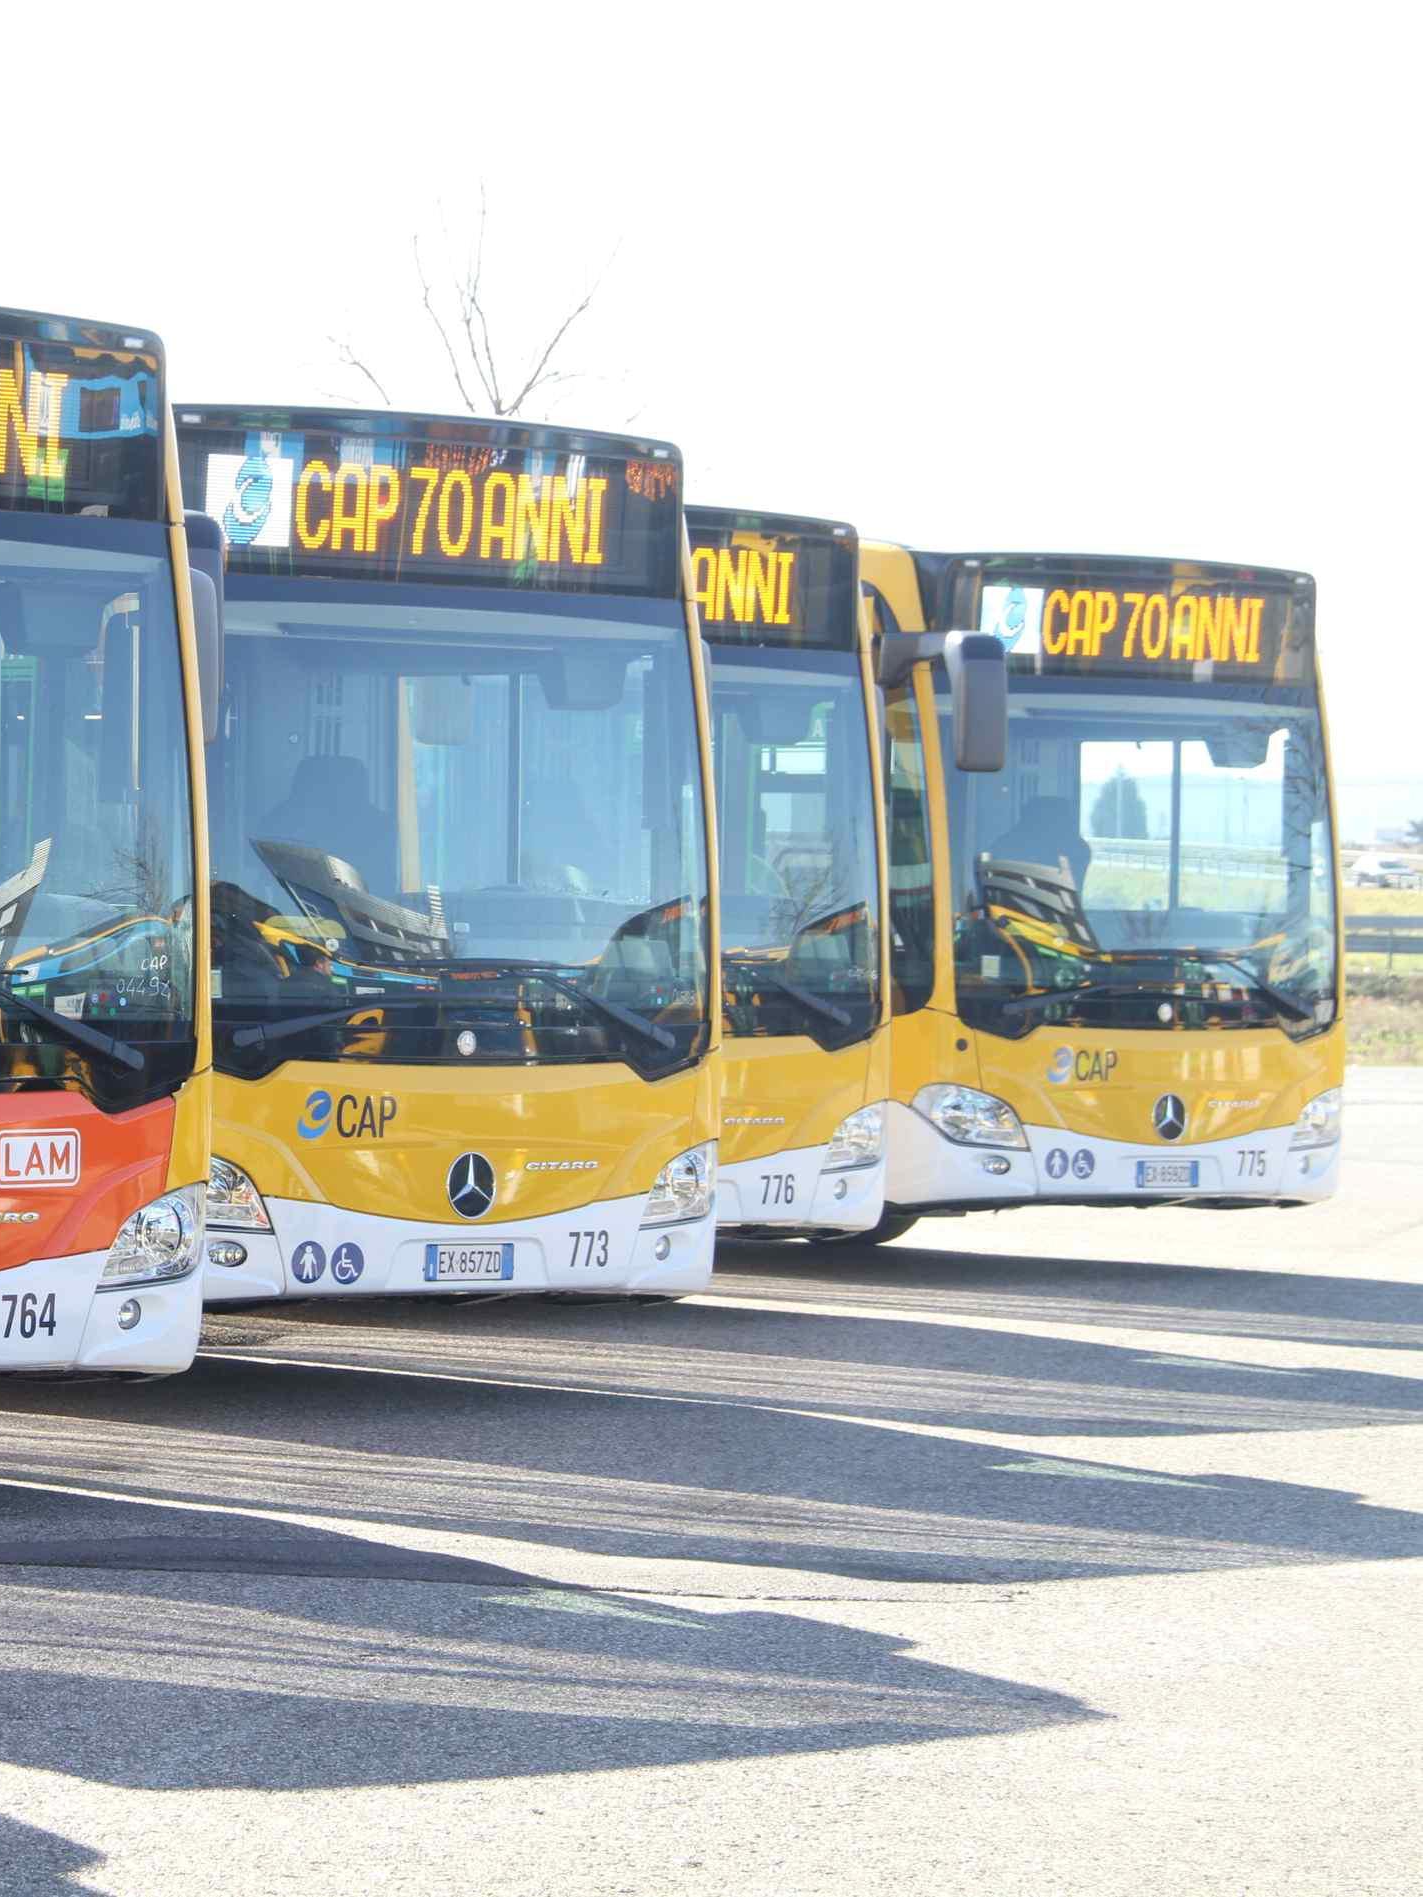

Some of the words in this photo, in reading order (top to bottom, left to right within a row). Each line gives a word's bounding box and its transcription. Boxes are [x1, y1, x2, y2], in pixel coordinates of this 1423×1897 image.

[294, 459, 402, 553] CAP
[409, 466, 474, 557] 70
[479, 471, 608, 566] ANNI
[690, 547, 795, 625] ANNI
[1041, 589, 1116, 658] CAP
[1122, 592, 1169, 659] 70
[1169, 594, 1266, 664] ANNI
[139, 953, 169, 972] CAP
[1076, 1050, 1118, 1082] CAP
[336, 1093, 397, 1138] CAP
[3, 1140, 72, 1177] LAM
[1237, 1149, 1267, 1177] 775
[760, 1174, 795, 1205] 776
[568, 1230, 609, 1269] 773
[1, 1293, 57, 1338] 764
